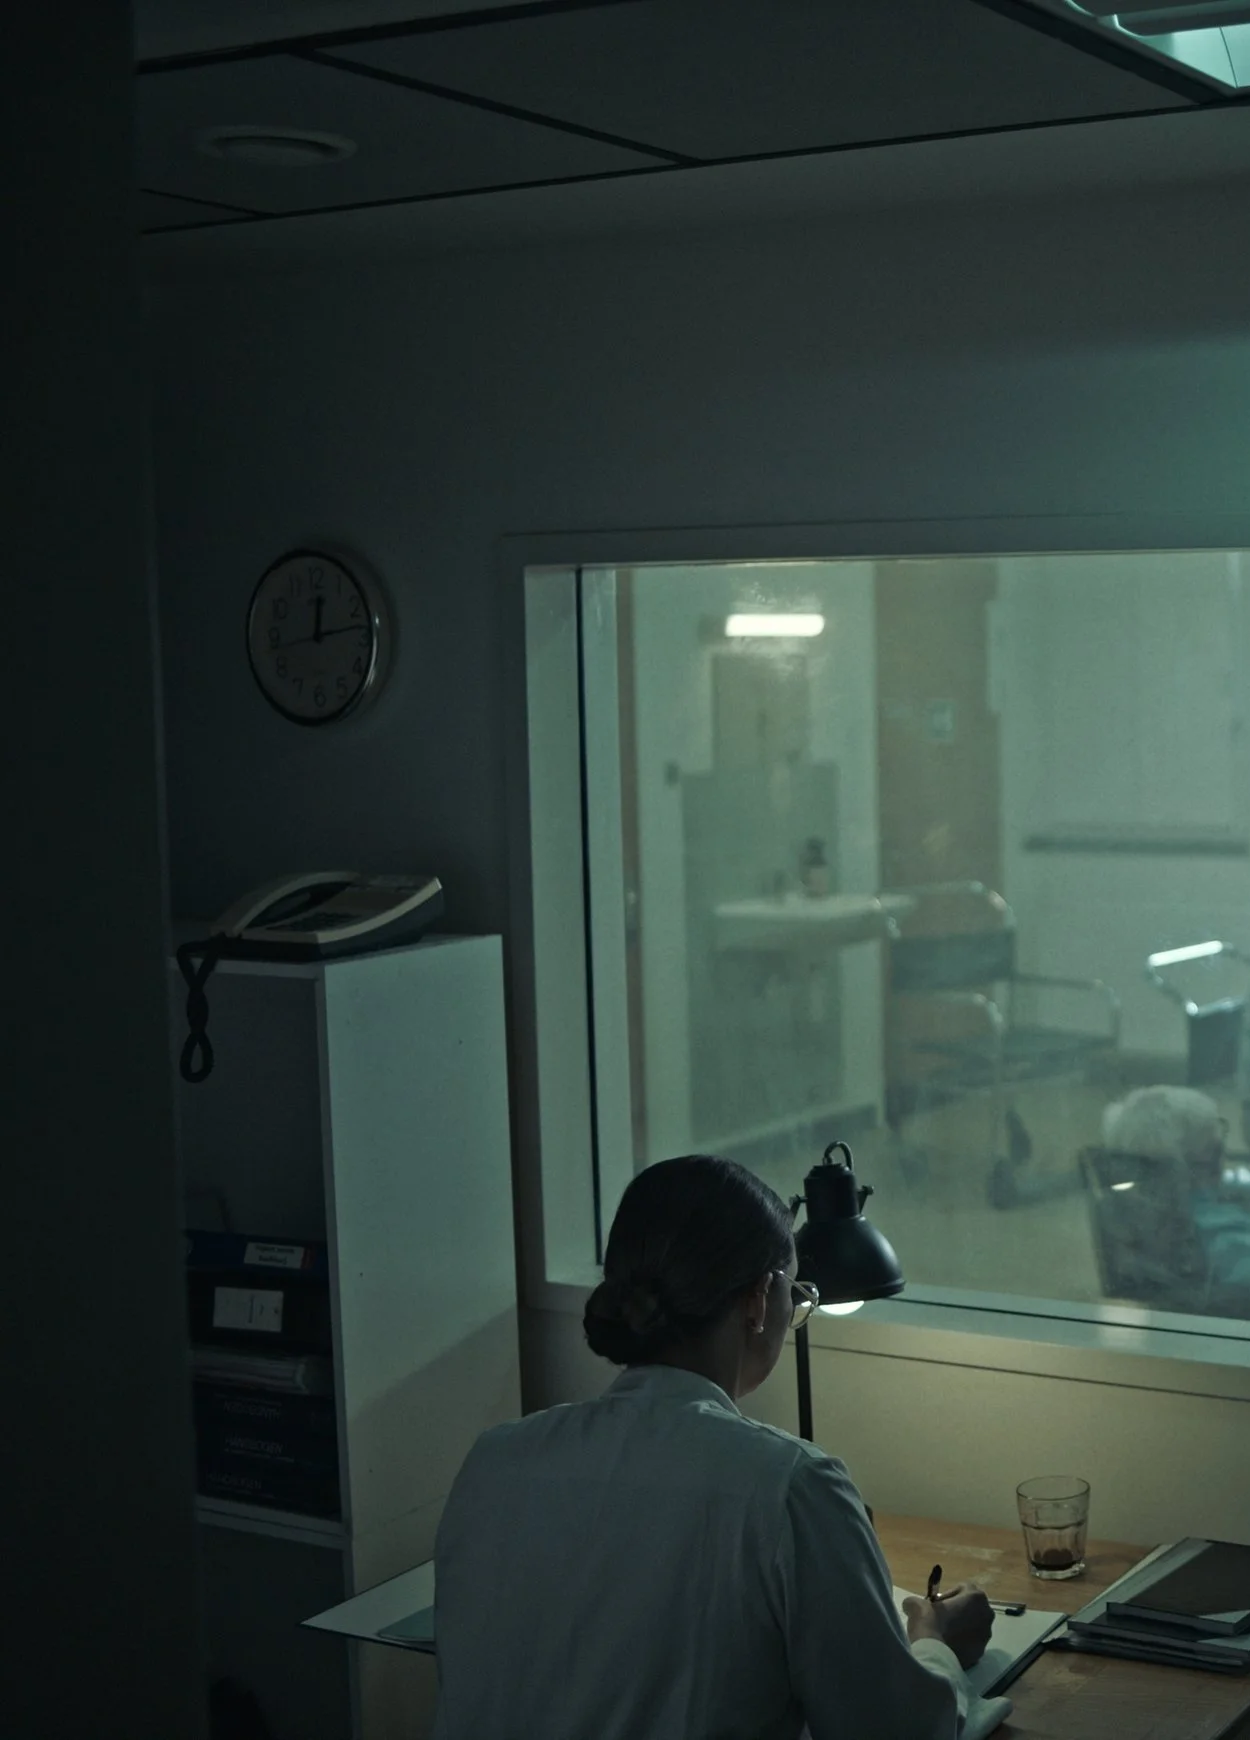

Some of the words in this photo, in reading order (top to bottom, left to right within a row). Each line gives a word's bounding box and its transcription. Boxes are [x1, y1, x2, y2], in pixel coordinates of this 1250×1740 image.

[289, 573, 301, 597] 11
[308, 567, 324, 590] 12
[272, 598, 288, 620] 10
[349, 596, 362, 619] 2
[268, 627, 280, 649] 9
[358, 633, 370, 648] 3
[276, 656, 287, 678] 8
[352, 657, 362, 674] 4
[292, 679, 303, 696] 7
[314, 686, 327, 707] 6
[336, 678, 348, 698] 5
